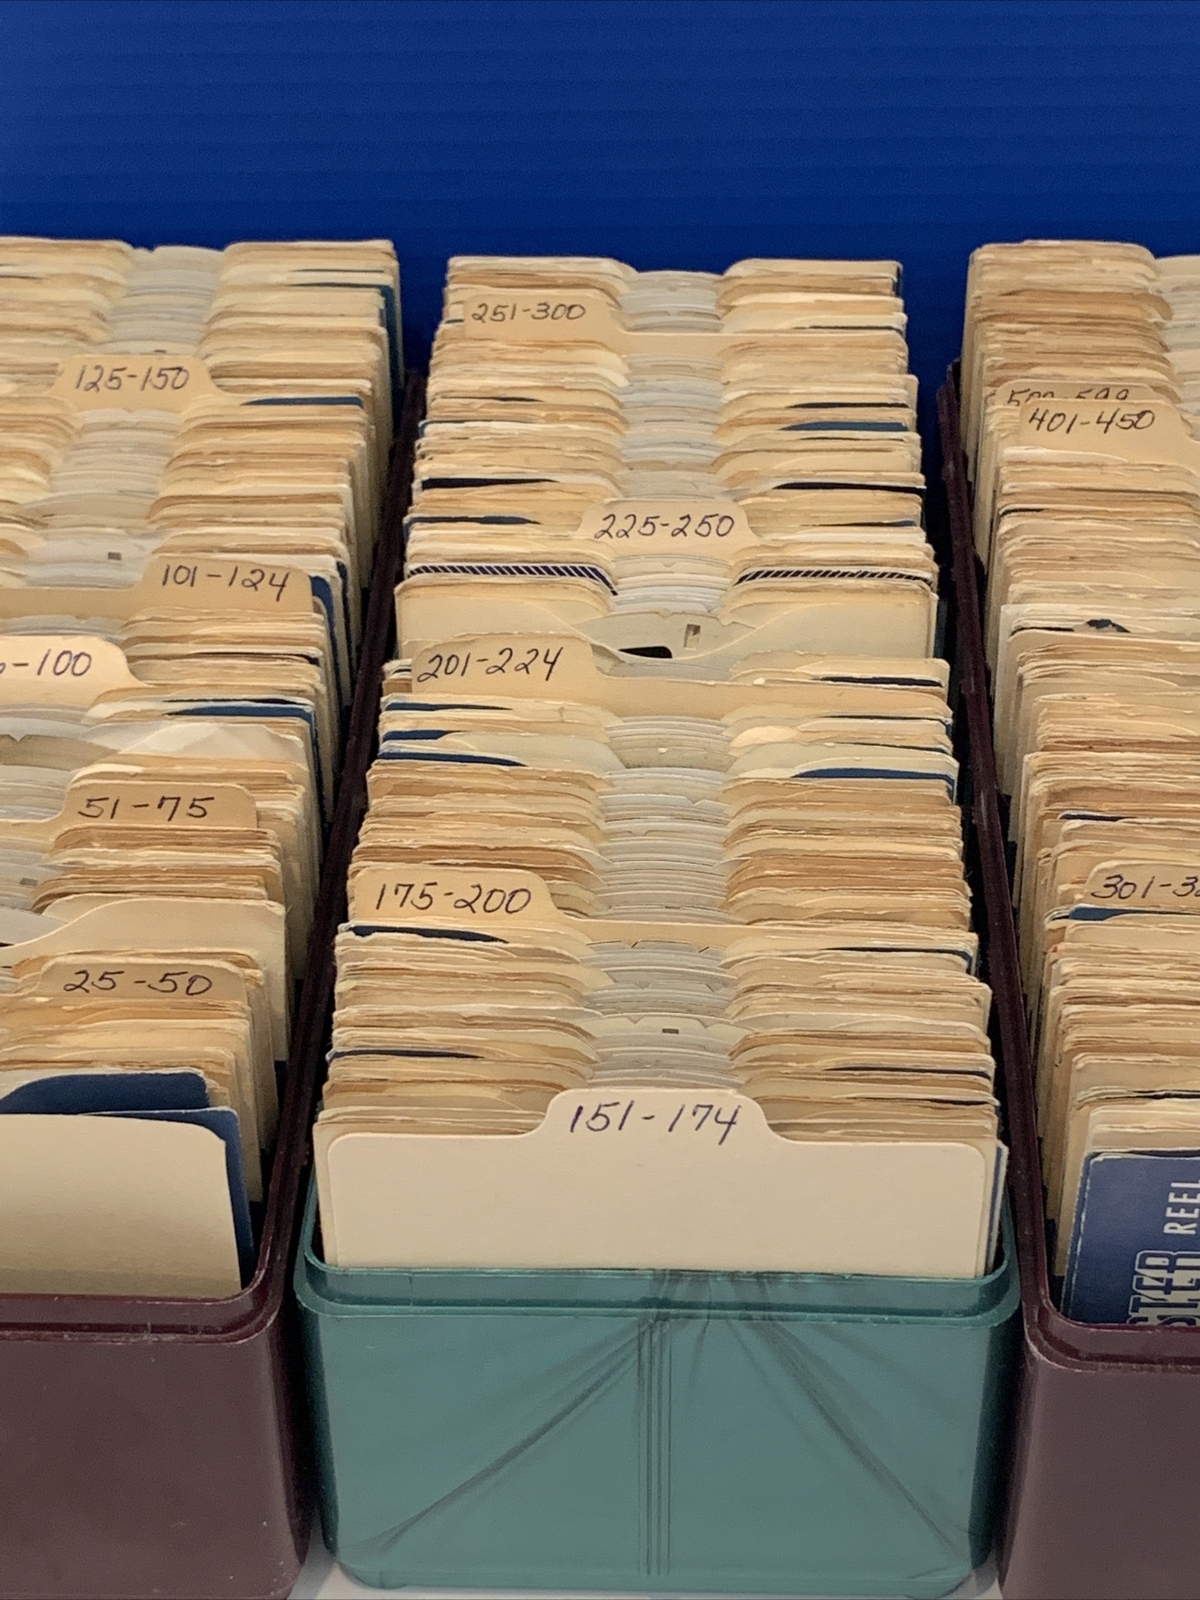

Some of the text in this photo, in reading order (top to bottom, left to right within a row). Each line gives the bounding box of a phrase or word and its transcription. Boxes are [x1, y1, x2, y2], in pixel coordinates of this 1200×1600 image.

[471, 302, 586, 324] 251-300
[76, 364, 189, 392] 125-150
[1028, 406, 1156, 435] 401-450
[594, 513, 735, 540] 225-250
[416, 646, 564, 683] 201-224
[375, 881, 532, 915] 175-200
[569, 1099, 742, 1146] 151-174
[1163, 1182, 1200, 1236] REEL
